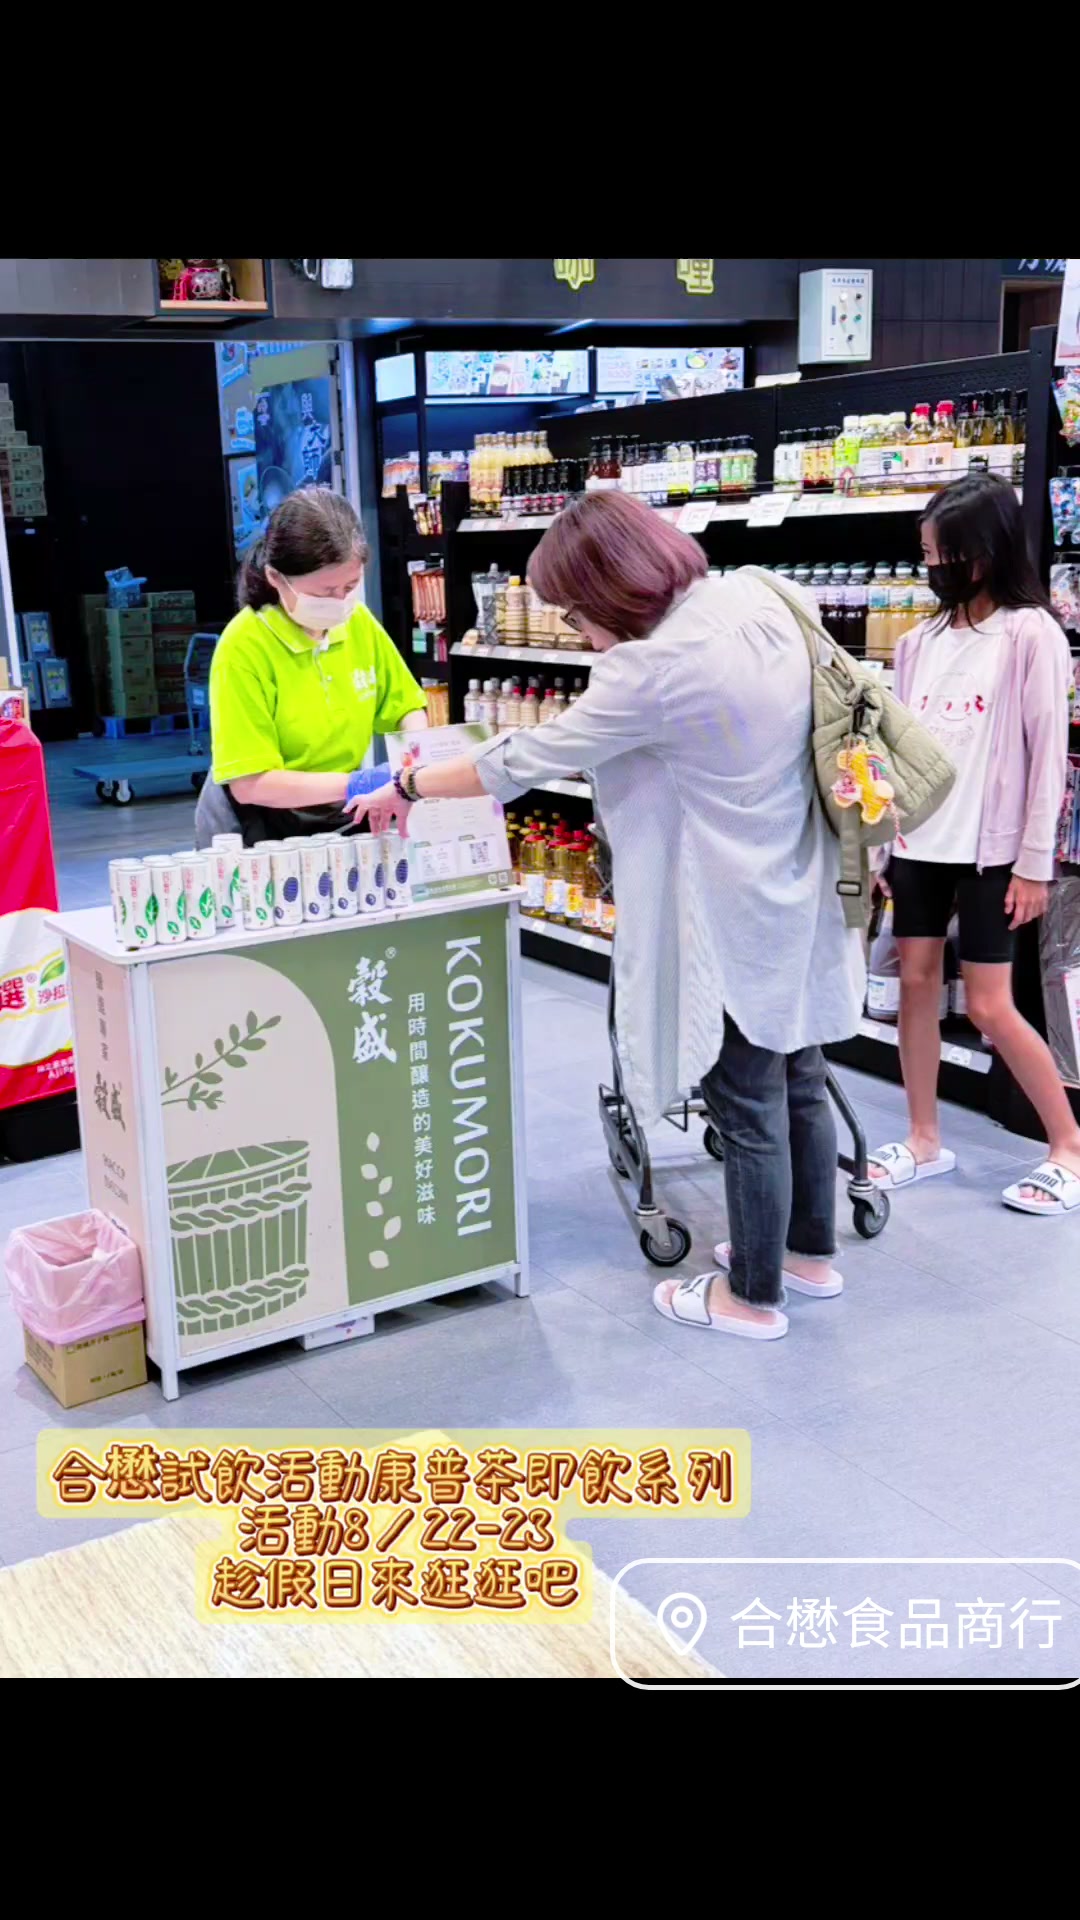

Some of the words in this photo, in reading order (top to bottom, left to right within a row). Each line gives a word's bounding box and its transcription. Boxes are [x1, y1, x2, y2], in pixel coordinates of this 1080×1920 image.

[347, 957, 397, 1064] 穀盛
[407, 992, 436, 1226] 用時間釀造的美好滋味
[445, 935, 492, 1237] KOKUMORI
